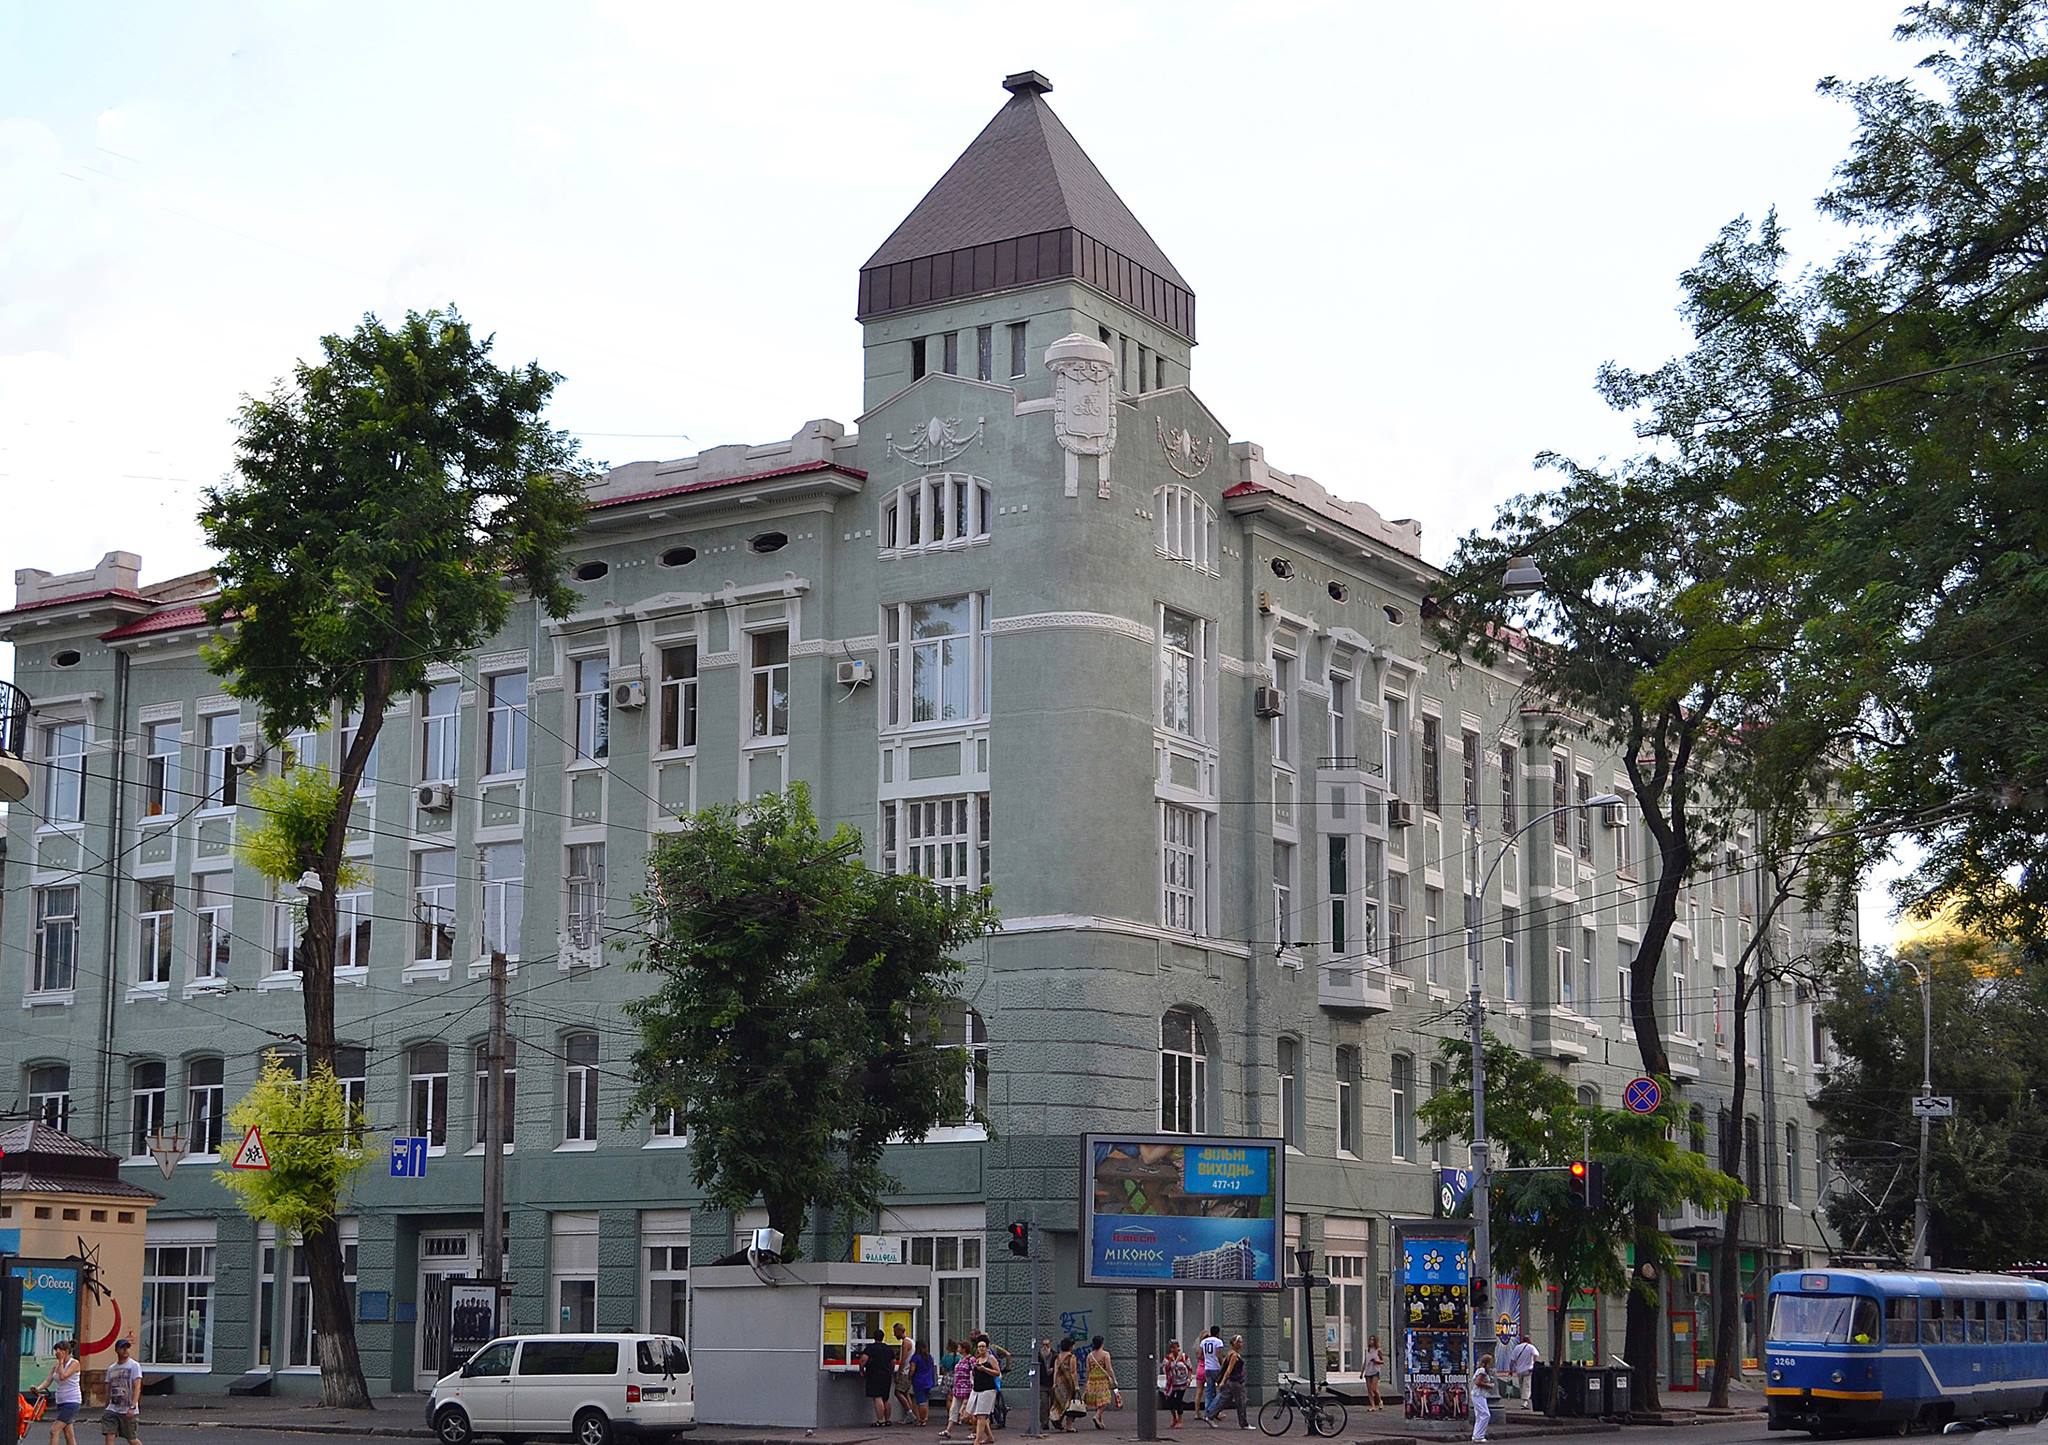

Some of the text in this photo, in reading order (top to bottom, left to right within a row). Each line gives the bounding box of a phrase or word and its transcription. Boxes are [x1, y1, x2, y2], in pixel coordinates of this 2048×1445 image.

[865, 1253, 897, 1262] ФАЛАФЕЛЬ
[1104, 1248, 1164, 1261] МІКОНОС
[1204, 1342, 1213, 1354] 10
[1775, 1357, 1796, 1366] 3268
[1413, 1374, 1441, 1383] LOBODA
